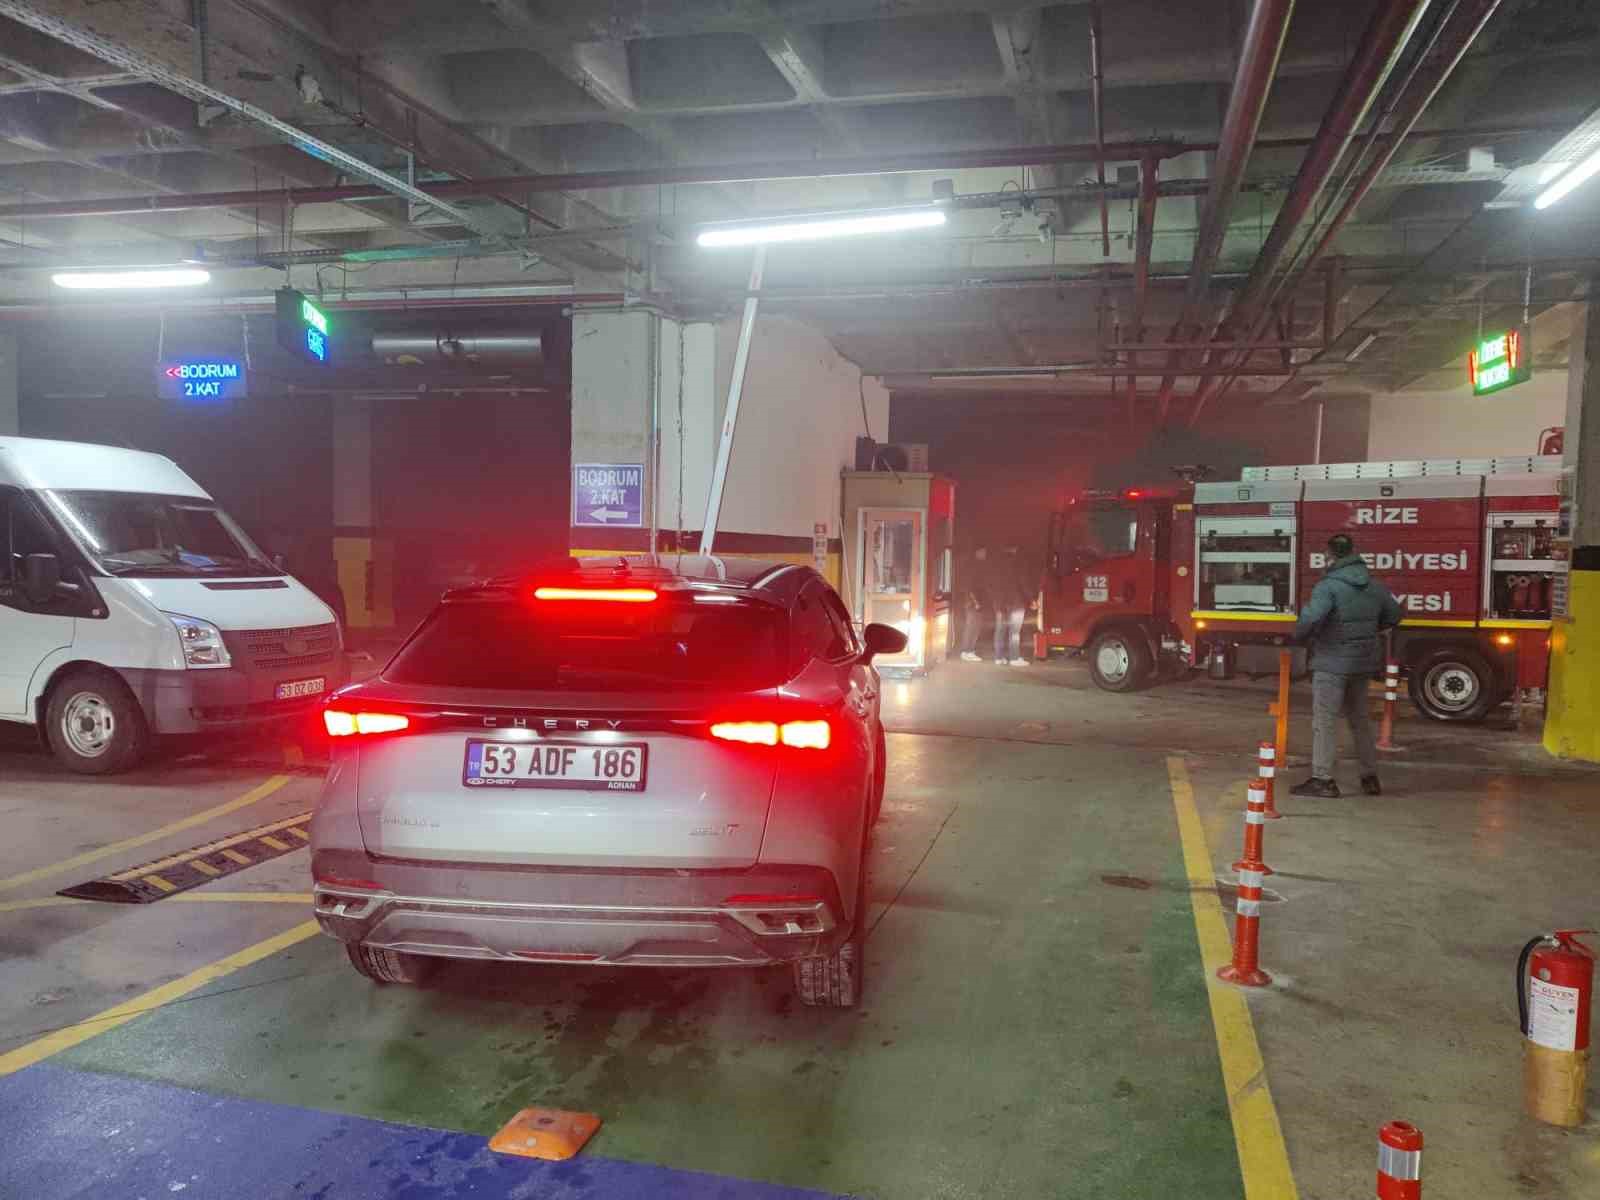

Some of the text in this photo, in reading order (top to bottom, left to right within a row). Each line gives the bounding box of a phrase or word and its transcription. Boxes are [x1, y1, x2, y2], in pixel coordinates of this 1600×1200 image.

[180, 364, 238, 379] BODRUM
[579, 470, 639, 487] BODRUM
[1356, 504, 1419, 525] RİZE
[1309, 549, 1469, 571] BEDİYESİ
[1086, 575, 1107, 588] 112
[482, 716, 622, 730] CHERY
[484, 746, 517, 775] 53
[527, 747, 577, 777] ADF
[592, 750, 637, 778] 186
[486, 778, 519, 786] CHERY
